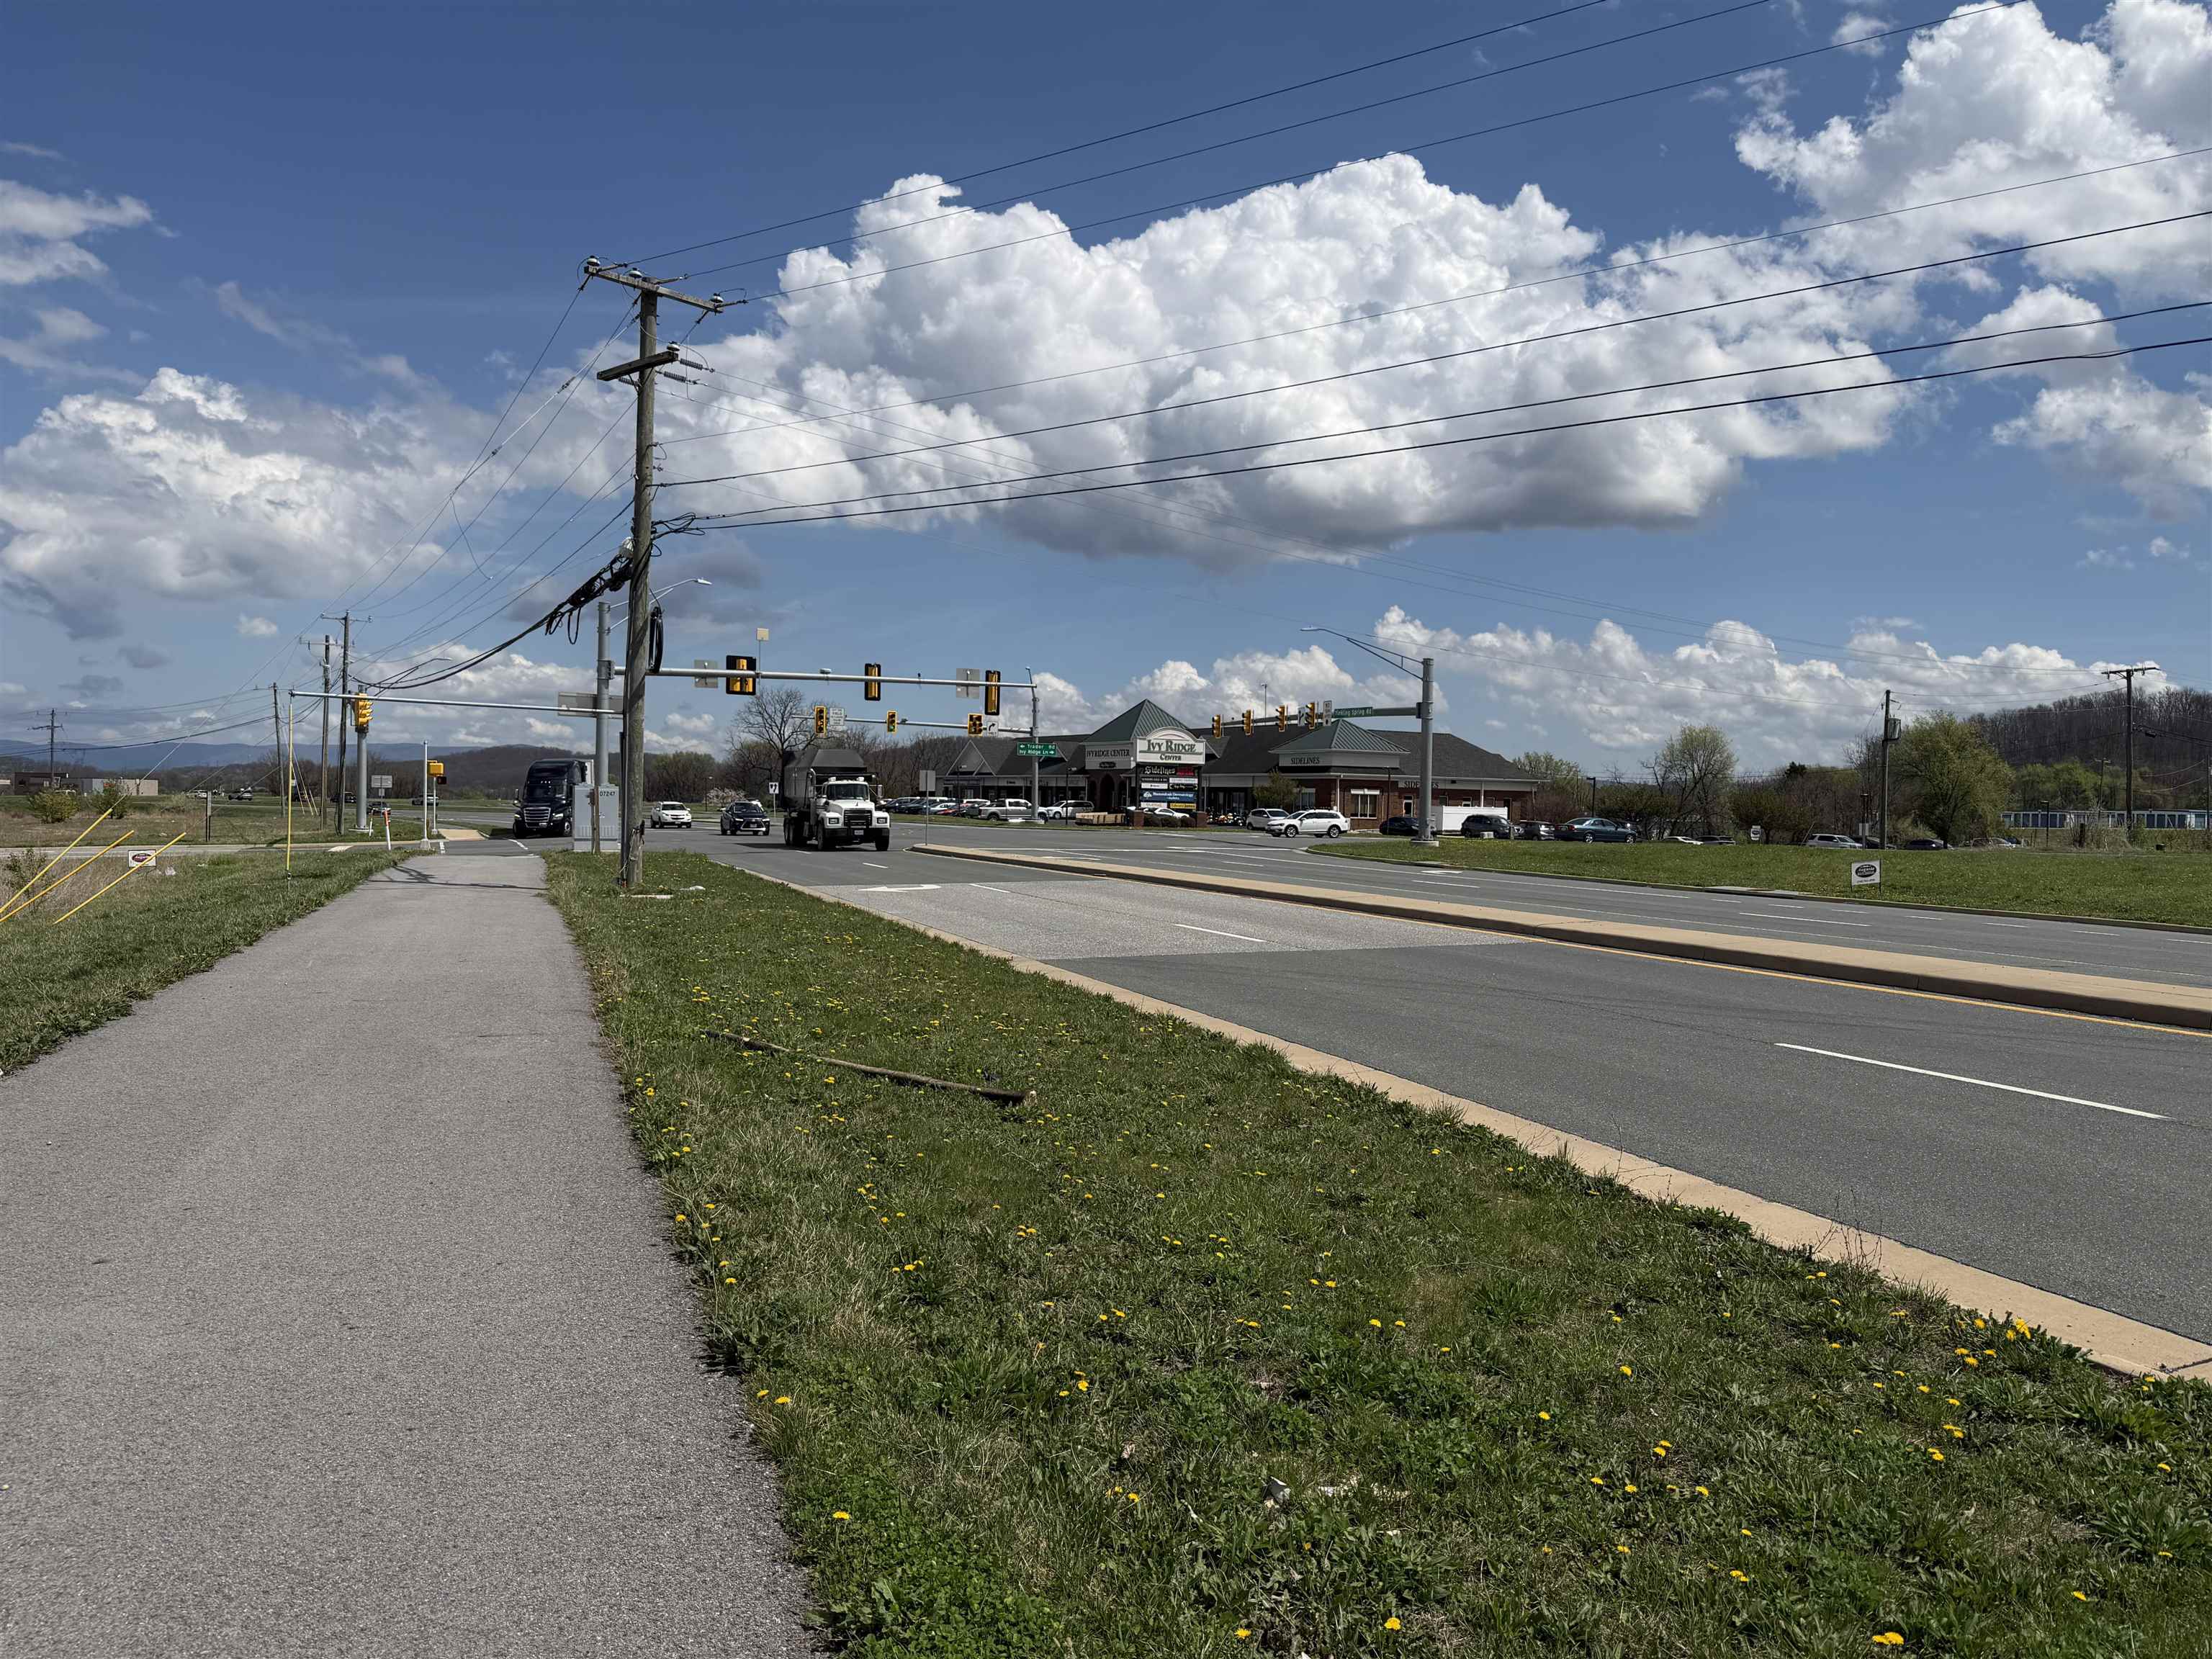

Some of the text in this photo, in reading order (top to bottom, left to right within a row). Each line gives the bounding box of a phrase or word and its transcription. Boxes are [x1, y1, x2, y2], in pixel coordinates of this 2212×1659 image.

[1146, 739, 1197, 752] IVY RIDGE
[1145, 766, 1175, 775] Sidelines
